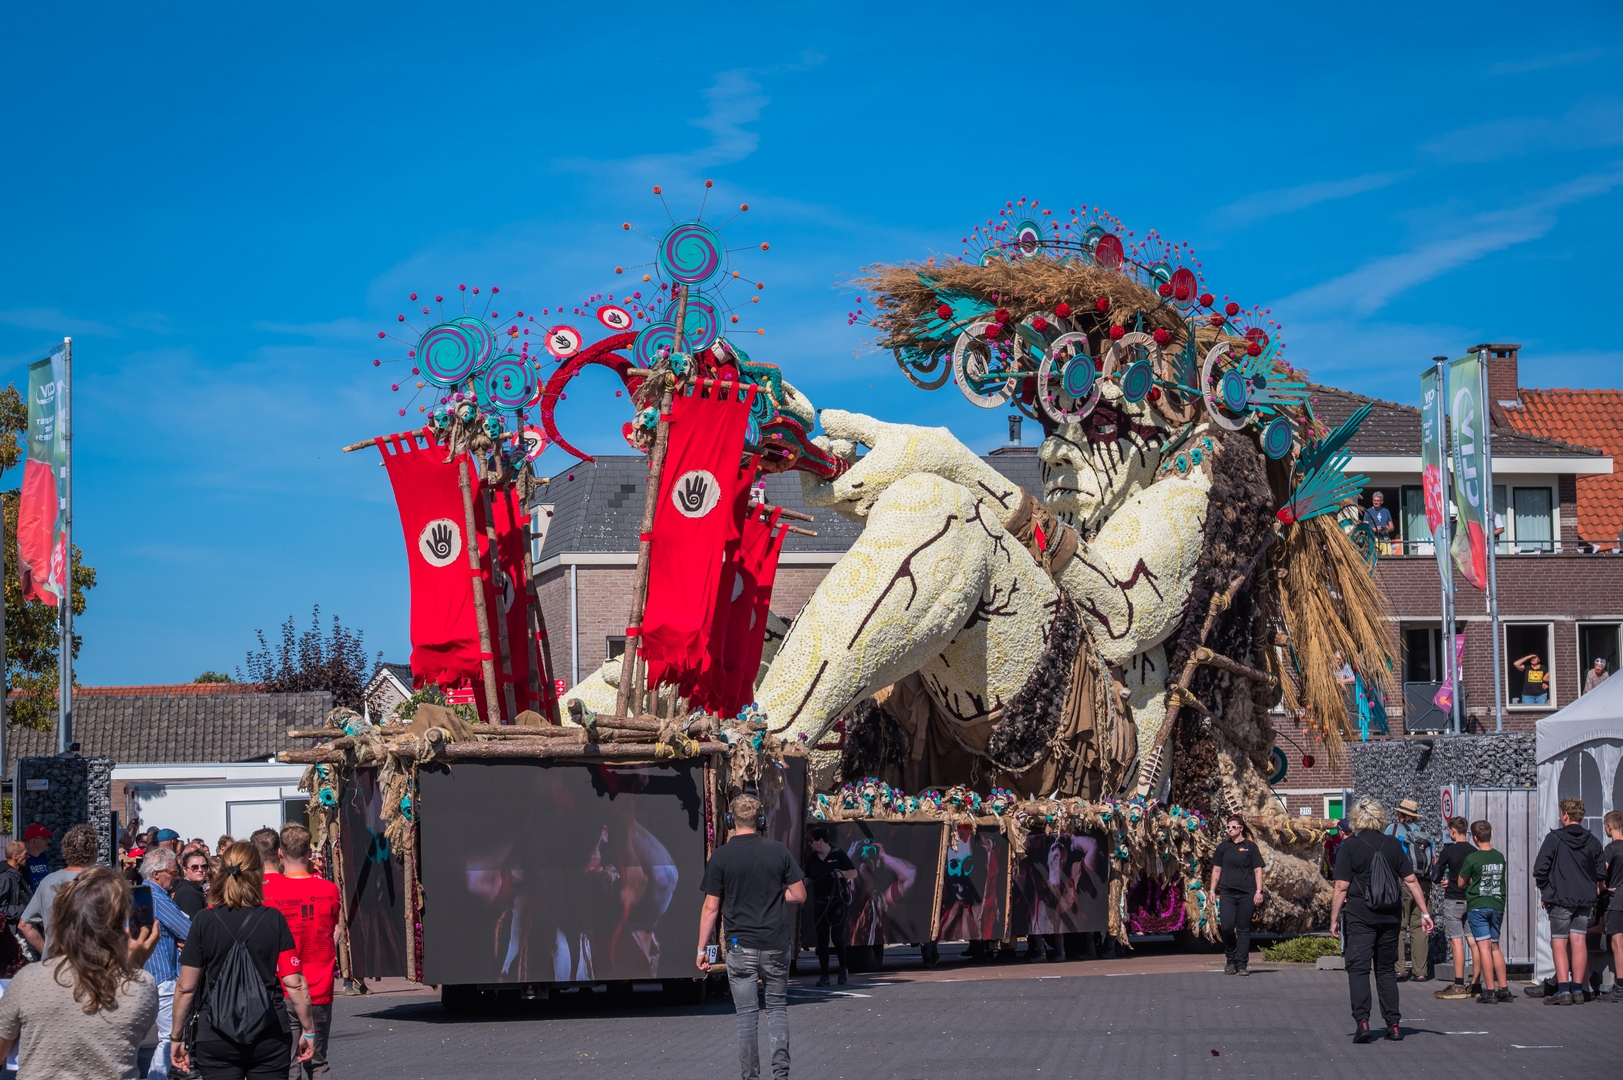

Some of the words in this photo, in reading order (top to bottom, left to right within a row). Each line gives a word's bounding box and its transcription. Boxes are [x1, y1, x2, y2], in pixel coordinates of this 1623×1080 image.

[1444, 799, 1451, 812] 15
[1301, 807, 1311, 815] 210
[708, 947, 717, 957] 19
